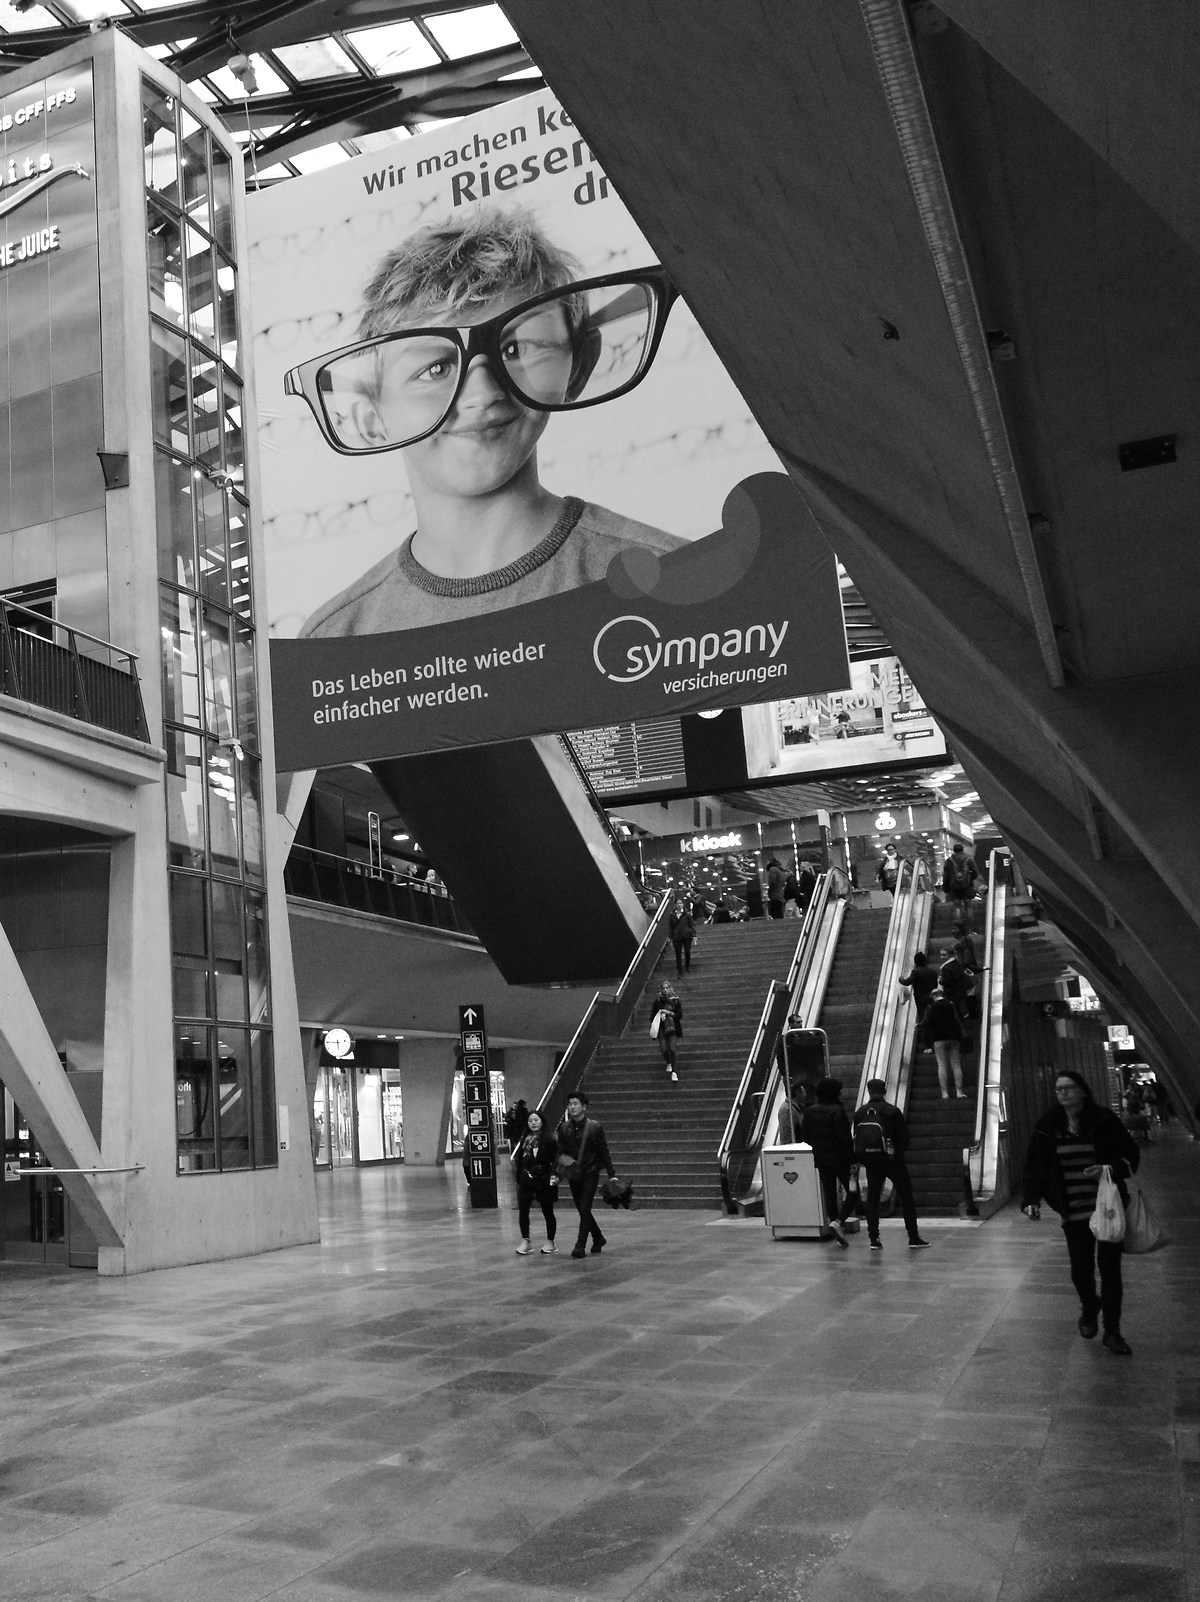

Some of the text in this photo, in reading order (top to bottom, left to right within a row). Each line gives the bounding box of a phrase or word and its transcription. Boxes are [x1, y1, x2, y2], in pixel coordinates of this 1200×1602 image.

[15, 103, 44, 125] CFF
[46, 87, 77, 111] FFS
[362, 164, 408, 196] Wir
[416, 125, 527, 179] machen
[18, 225, 59, 260] JUICE
[626, 620, 790, 673] sympany
[311, 642, 546, 699] Das Leben sollte wieder
[663, 663, 788, 695] versicherungen
[313, 681, 489, 725] einfacher werden.
[776, 684, 920, 721] ERINNERUNGE
[692, 832, 742, 852] kiosk
